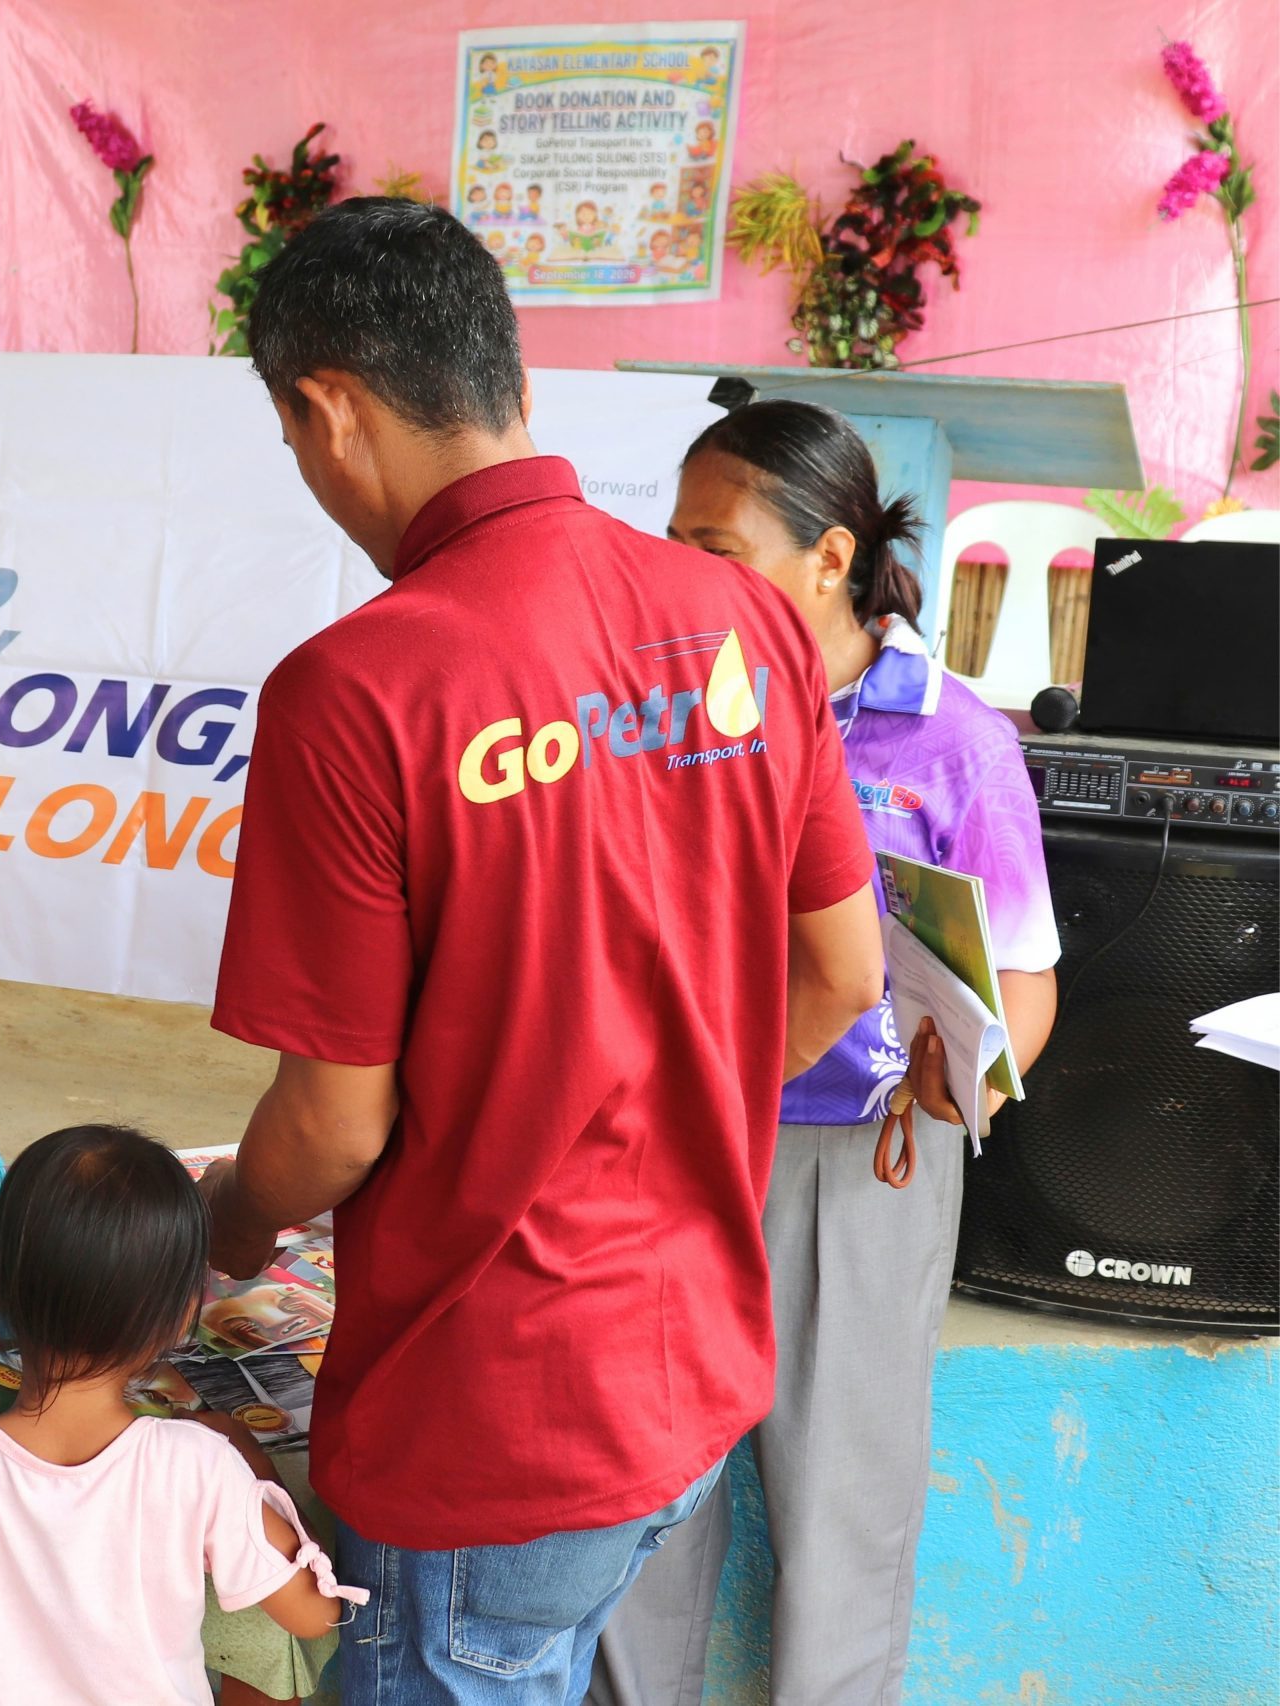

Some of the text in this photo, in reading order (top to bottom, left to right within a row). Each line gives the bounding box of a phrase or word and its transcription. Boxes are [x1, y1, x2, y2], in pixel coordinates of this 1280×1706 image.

[562, 53, 638, 70] ELEMENTARY
[642, 51, 691, 68] SCHOOL
[514, 90, 676, 109] BOOK DONATION AND
[499, 110, 688, 133] STORY TELLING ACTIVITY
[580, 136, 627, 150] Transport
[520, 153, 551, 165] SIKAP
[554, 152, 593, 163] TULONG
[596, 152, 637, 163] SULONG
[513, 167, 667, 179] Corporate Social Responsibility
[584, 181, 628, 194] Program
[580, 475, 659, 498] forward
[667, 741, 745, 771] Transport,
[1096, 1257, 1193, 1286] CROWN
